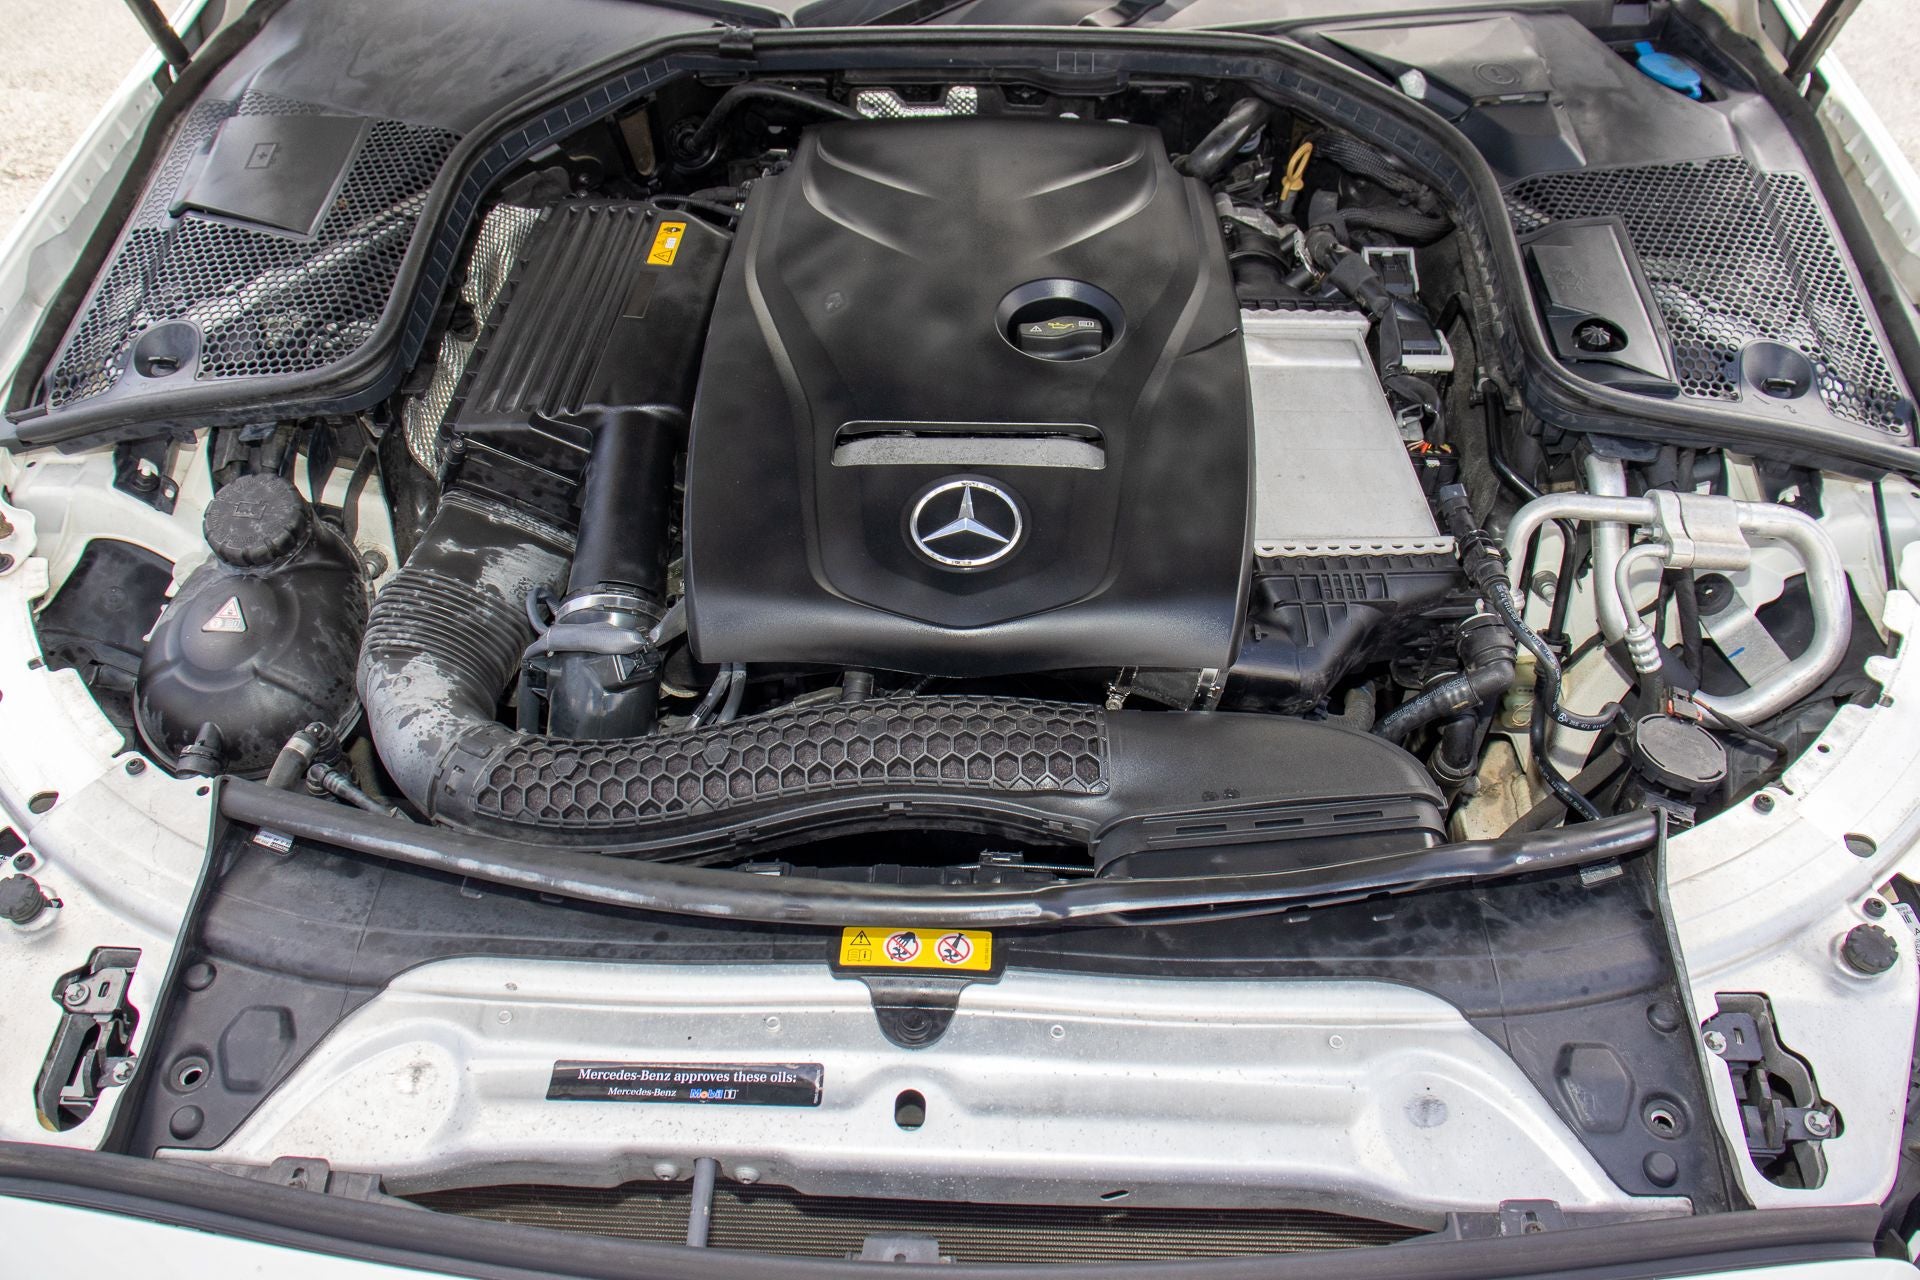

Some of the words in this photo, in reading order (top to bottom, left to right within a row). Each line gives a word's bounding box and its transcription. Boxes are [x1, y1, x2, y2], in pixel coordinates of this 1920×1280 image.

[578, 1068, 671, 1081] Mercedes-Benz
[674, 1071, 730, 1084] approves
[733, 1071, 767, 1083] these
[770, 1071, 797, 1083] oils:
[607, 1087, 677, 1097] Mercedes-Benz
[689, 1088, 724, 1099] Mobil
